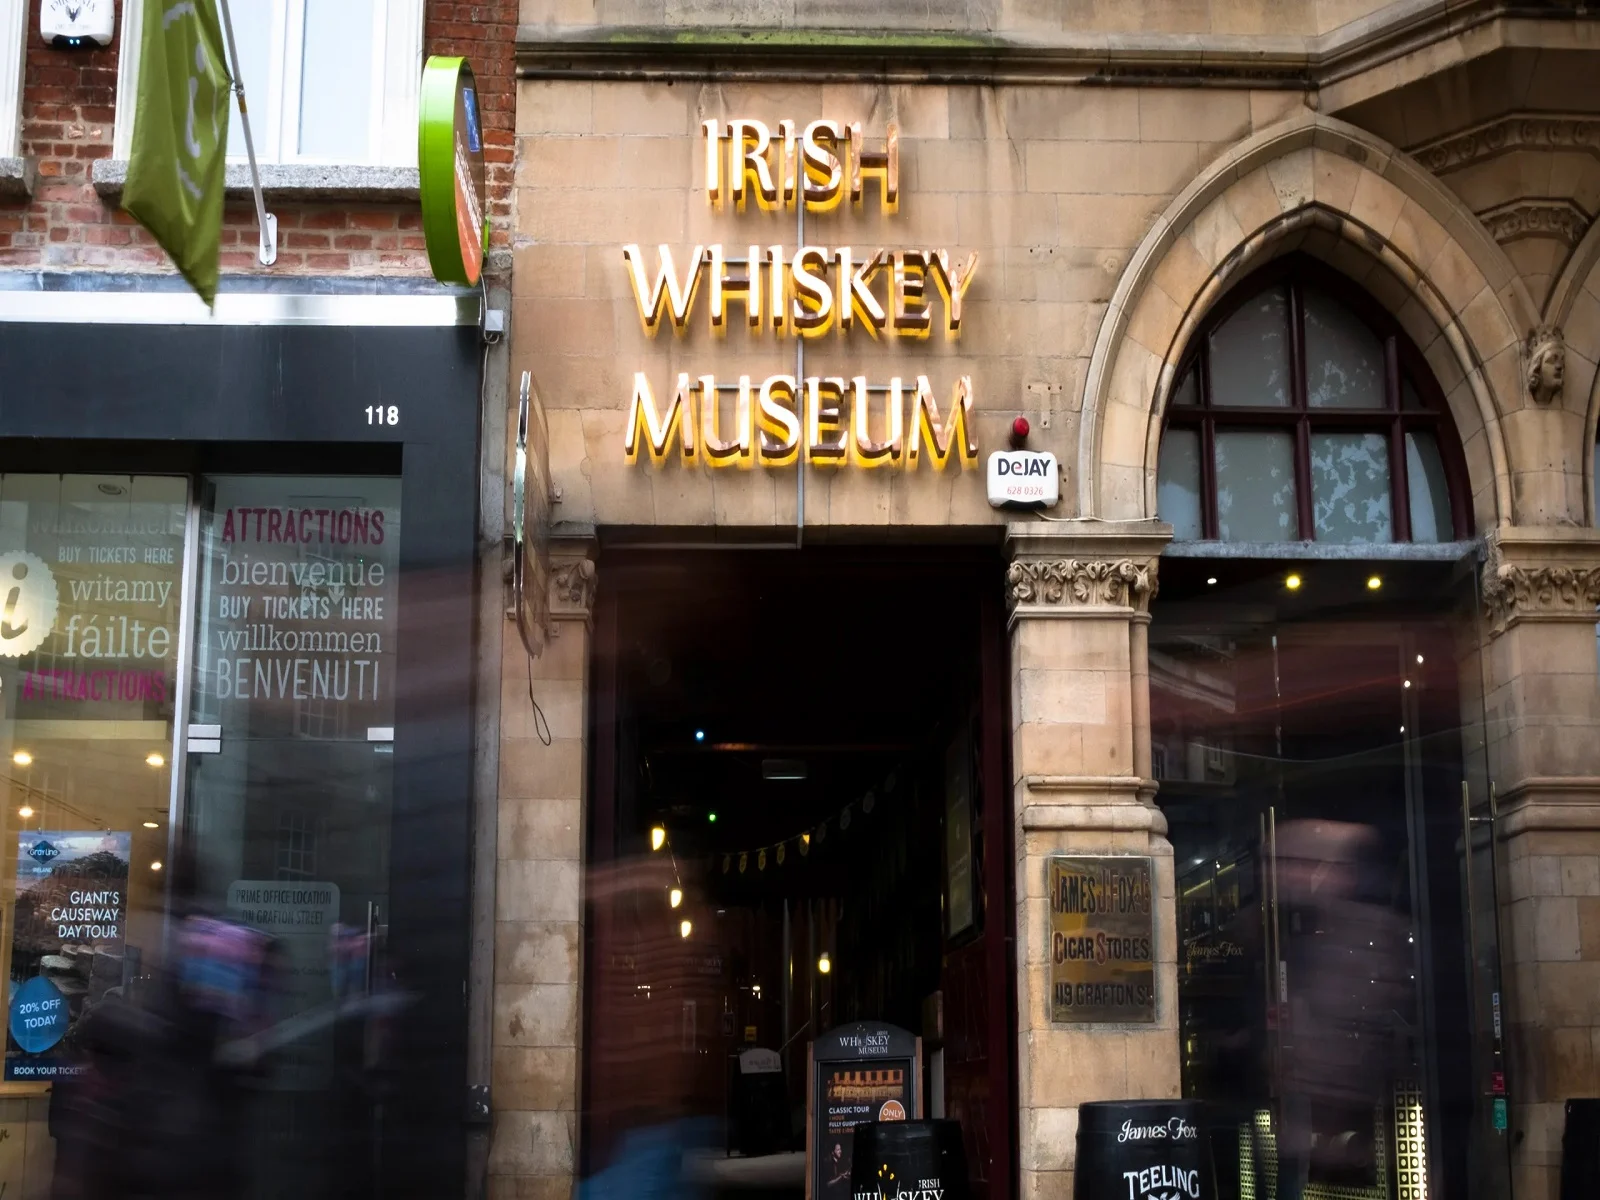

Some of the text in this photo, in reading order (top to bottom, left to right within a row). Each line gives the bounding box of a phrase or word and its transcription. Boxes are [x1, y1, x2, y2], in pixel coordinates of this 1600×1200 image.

[702, 119, 898, 205] IRISH
[623, 244, 980, 331] WHISKEY
[365, 405, 399, 425] 118
[624, 372, 980, 460] MUSEUM
[998, 458, 1051, 476] DeJAY
[1007, 486, 1044, 496] 628 0326
[221, 508, 385, 545] ATTRACTIONS
[58, 546, 174, 564] BUY TICKETS HERE
[219, 554, 385, 586] bienvenue
[69, 574, 172, 608] witamy
[219, 595, 384, 620] BUY TICKETS HERE
[64, 614, 170, 658] fáilte
[218, 624, 382, 653] willkommen
[22, 667, 167, 701] ATTRACTIONS
[216, 658, 379, 700] BENVENUTI
[70, 891, 120, 905] GIANT'S
[236, 889, 331, 905] PRIME OFFICE LOCATION
[1052, 867, 1096, 914] JAMES
[51, 908, 119, 921] CAUSEWAY
[242, 910, 324, 925] ON GRAFTON STREET
[58, 924, 117, 938] DAY TOUR
[1053, 932, 1149, 965] CIGAR STORES
[1055, 981, 1073, 1006] 119
[20, 999, 61, 1014] 20% OFF
[24, 1015, 57, 1028] TODAY
[859, 1046, 888, 1055] MUSEUM
[14, 1066, 35, 1075] BOOK
[36, 1066, 57, 1075] YOUR
[829, 1106, 852, 1114] CLASSIC
[882, 1108, 902, 1117] ONLY
[1117, 1117, 1197, 1142] James Fox
[918, 1178, 940, 1189] IRISH
[1123, 1165, 1200, 1200] TEELING
